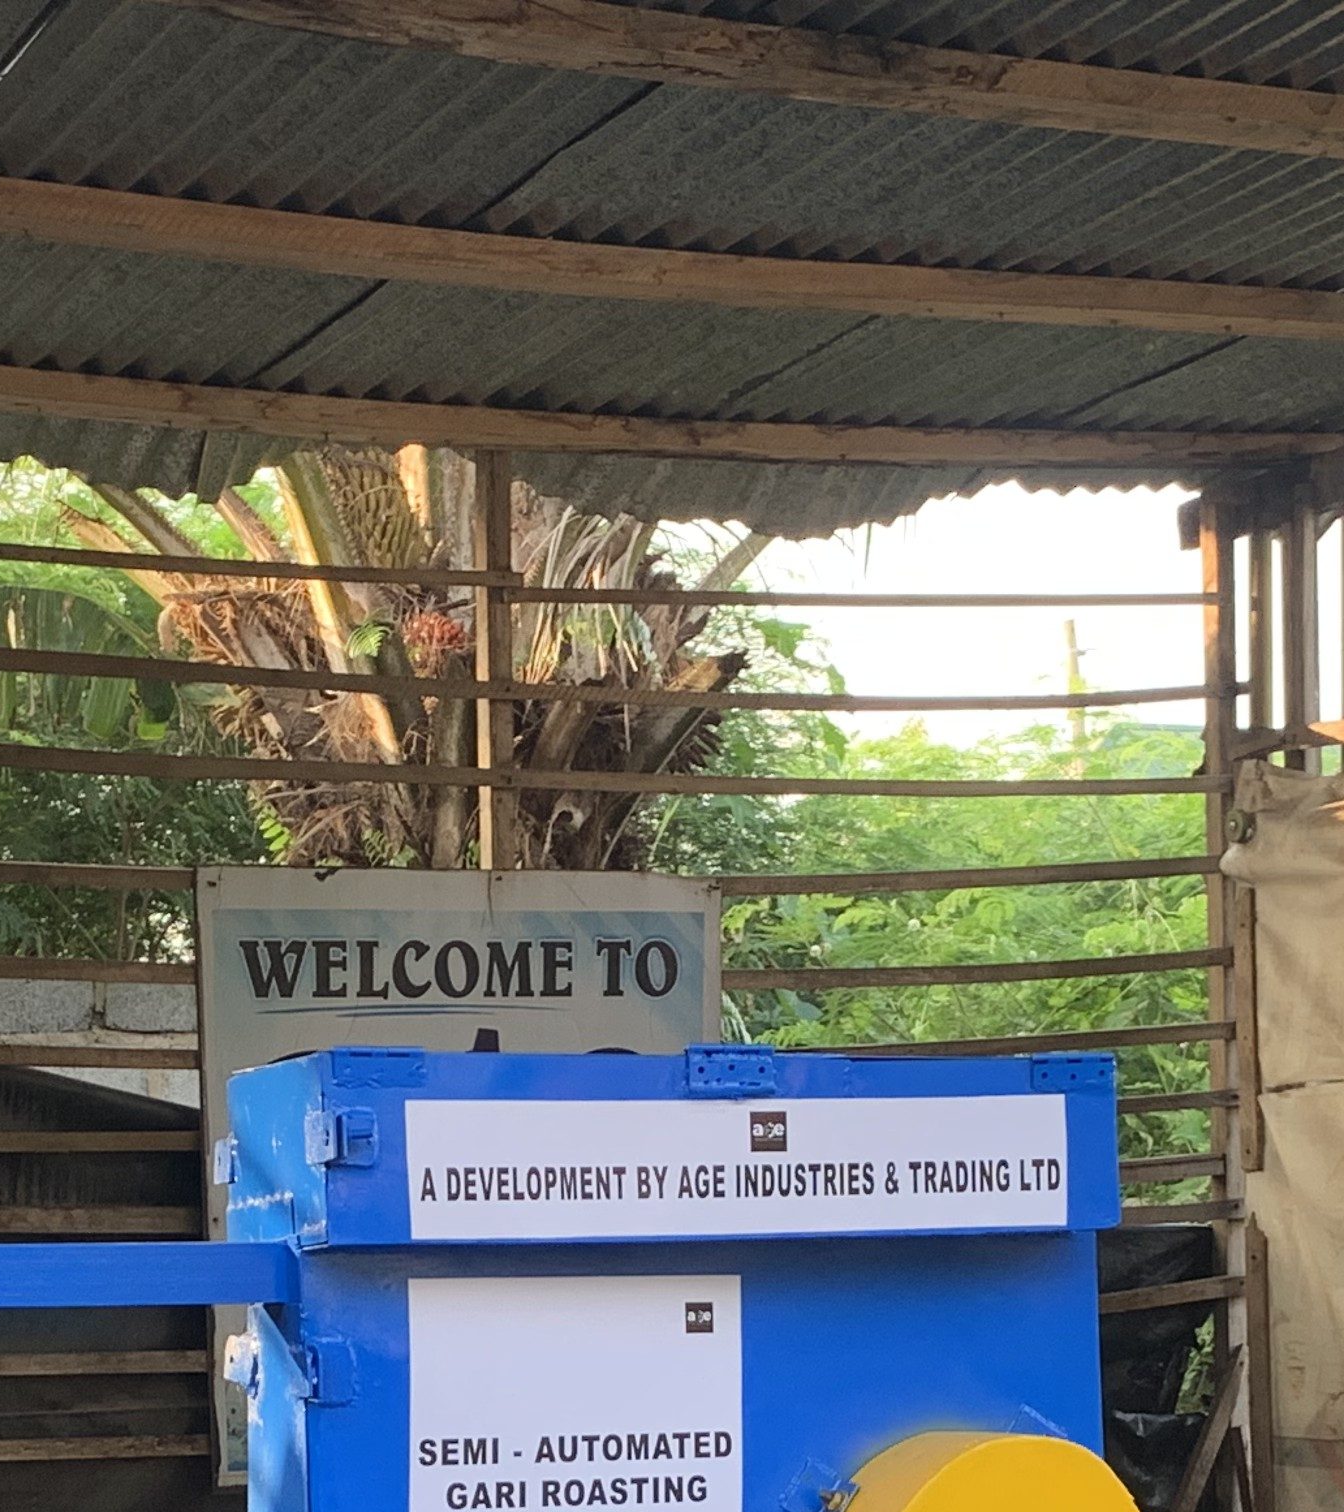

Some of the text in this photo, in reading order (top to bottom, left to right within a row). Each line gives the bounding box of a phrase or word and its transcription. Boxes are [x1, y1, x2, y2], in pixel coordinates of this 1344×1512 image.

[239, 938, 678, 1000] WELCOME TO
[420, 1157, 1062, 1201] A DEVELOPMENT BY AGE INDUSTRIES & TRADING LTD
[418, 1437, 499, 1467] SEMI
[534, 1431, 733, 1464] AUTOMATED
[445, 1475, 708, 1510] GARI ROASTING
